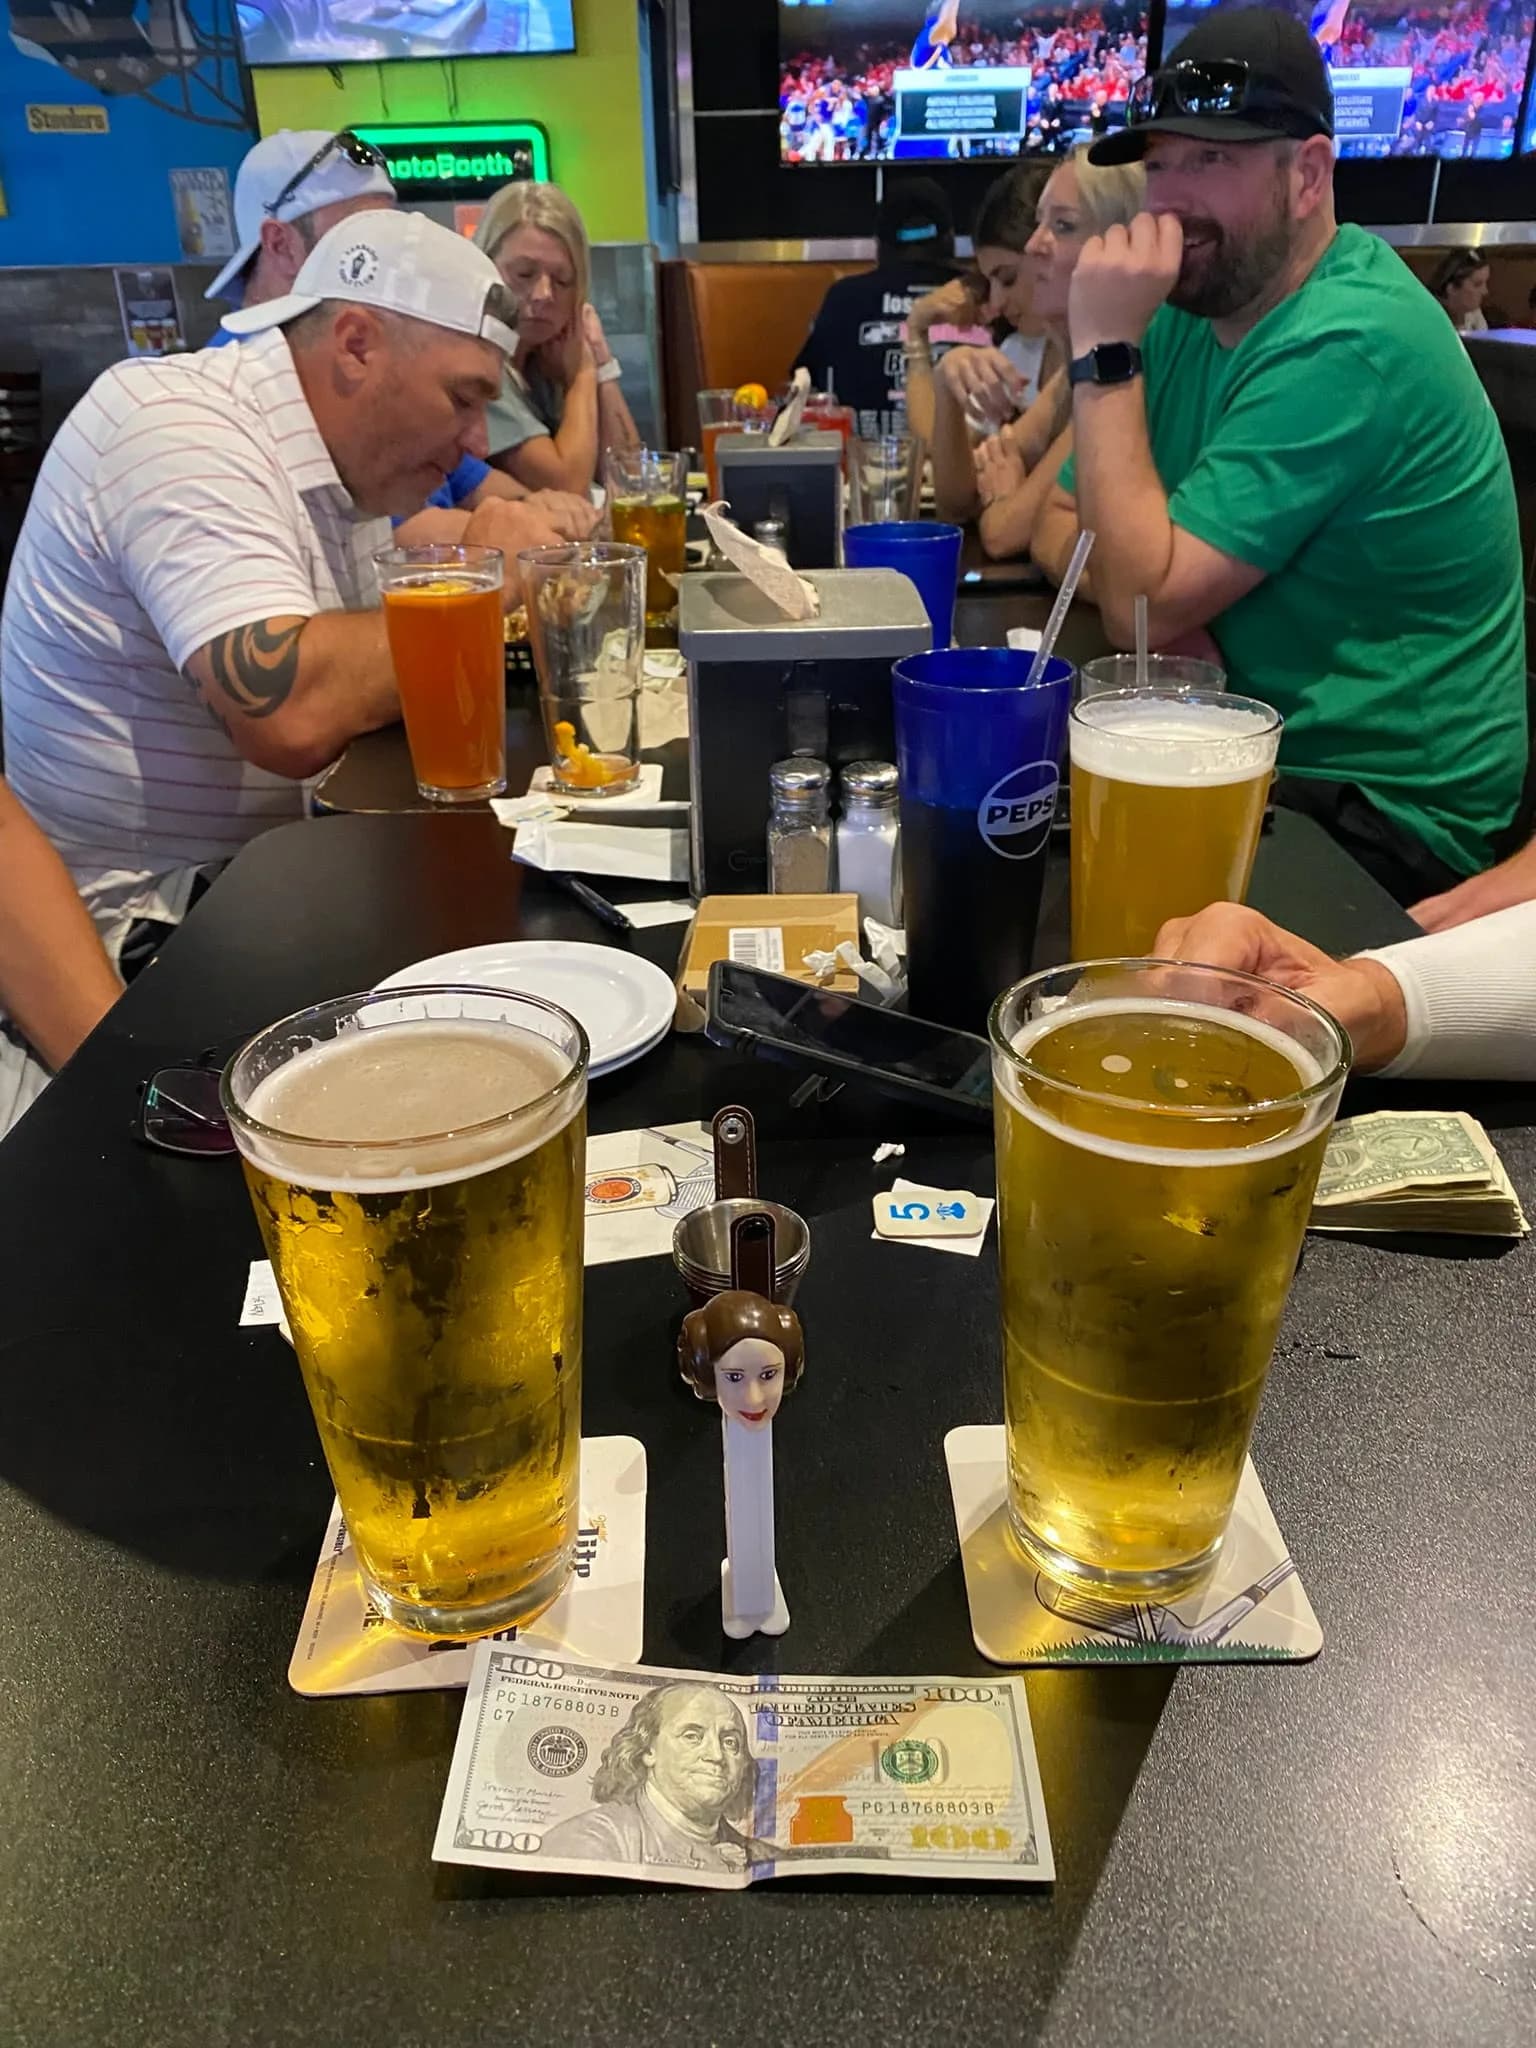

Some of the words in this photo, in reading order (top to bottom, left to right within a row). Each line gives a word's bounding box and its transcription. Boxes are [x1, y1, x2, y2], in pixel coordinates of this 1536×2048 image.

[387, 152, 513, 178] otoBooth
[882, 293, 913, 314] los
[986, 794, 1055, 825] PEPS
[888, 1202, 931, 1221] 5
[495, 1655, 564, 1680] 100
[500, 1675, 553, 1690] FEDERAL
[555, 1682, 608, 1697] RESERVE
[608, 1690, 640, 1701] NOTE
[923, 1687, 994, 1703] 100
[468, 1828, 542, 1853] 100
